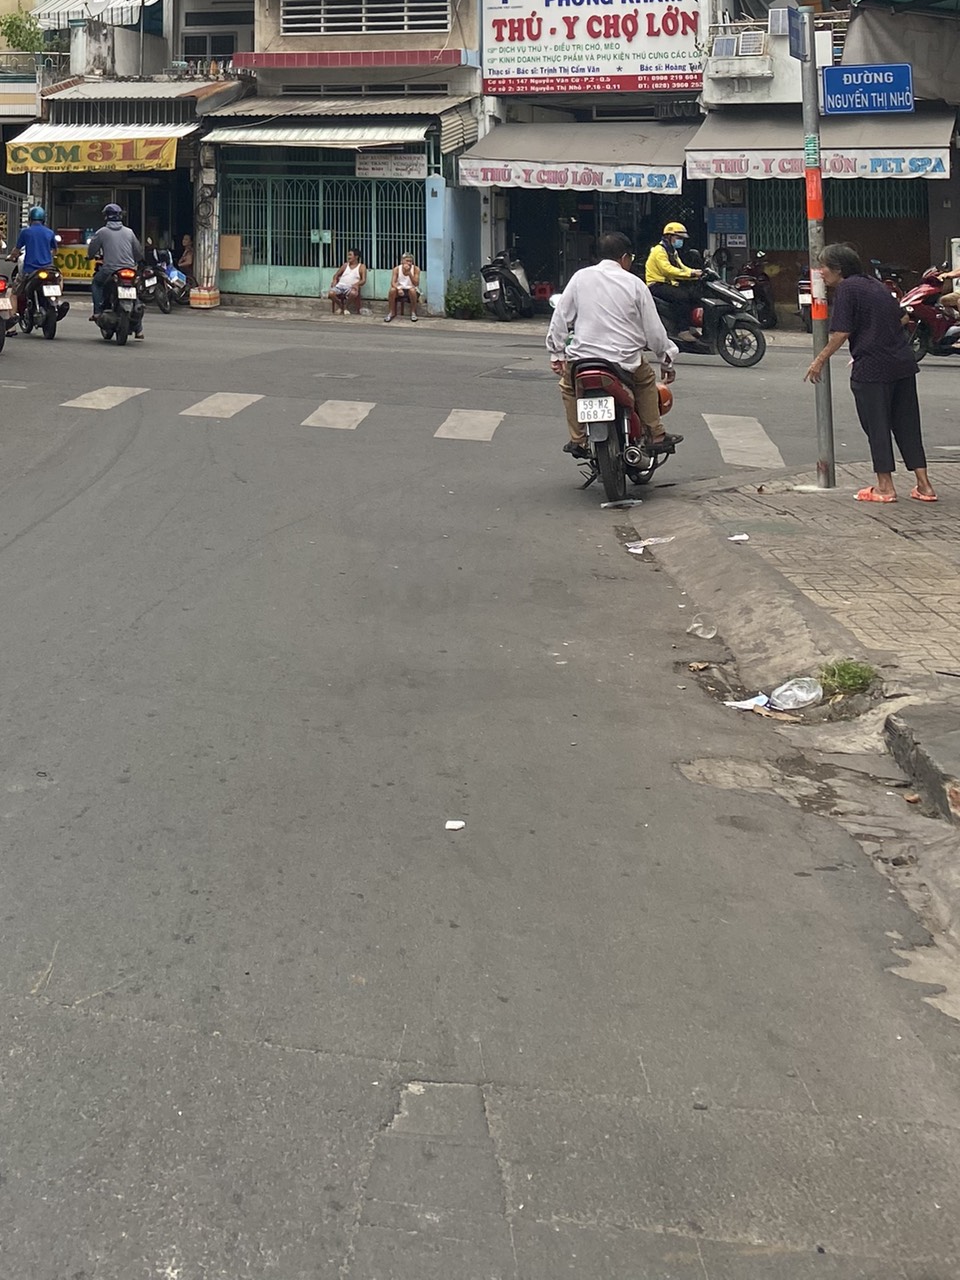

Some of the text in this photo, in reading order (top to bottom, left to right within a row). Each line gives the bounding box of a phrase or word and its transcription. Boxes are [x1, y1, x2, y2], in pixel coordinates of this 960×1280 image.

[492, 5, 700, 42] THÚ Y CHỢ LỚN
[671, 50, 686, 59] CÁC
[516, 67, 529, 75] Bác
[640, 63, 653, 72] Bác
[842, 70, 894, 85] ĐƯỜNG
[827, 86, 911, 110] NGUYỄN THỊ NHỎ
[10, 138, 171, 164] CƠM 317
[712, 153, 750, 173] THÚ
[761, 158, 775, 173] Y
[869, 157, 904, 173] PET
[908, 157, 947, 173] SPA
[480, 164, 512, 182] THÚ
[522, 168, 534, 183] Y
[536, 167, 570, 188] CHỢ
[571, 166, 604, 186] LỚN
[614, 172, 643, 187] PET
[646, 173, 678, 188] SPA
[583, 399, 609, 410] 59-M2
[580, 409, 613, 420] 068.75
